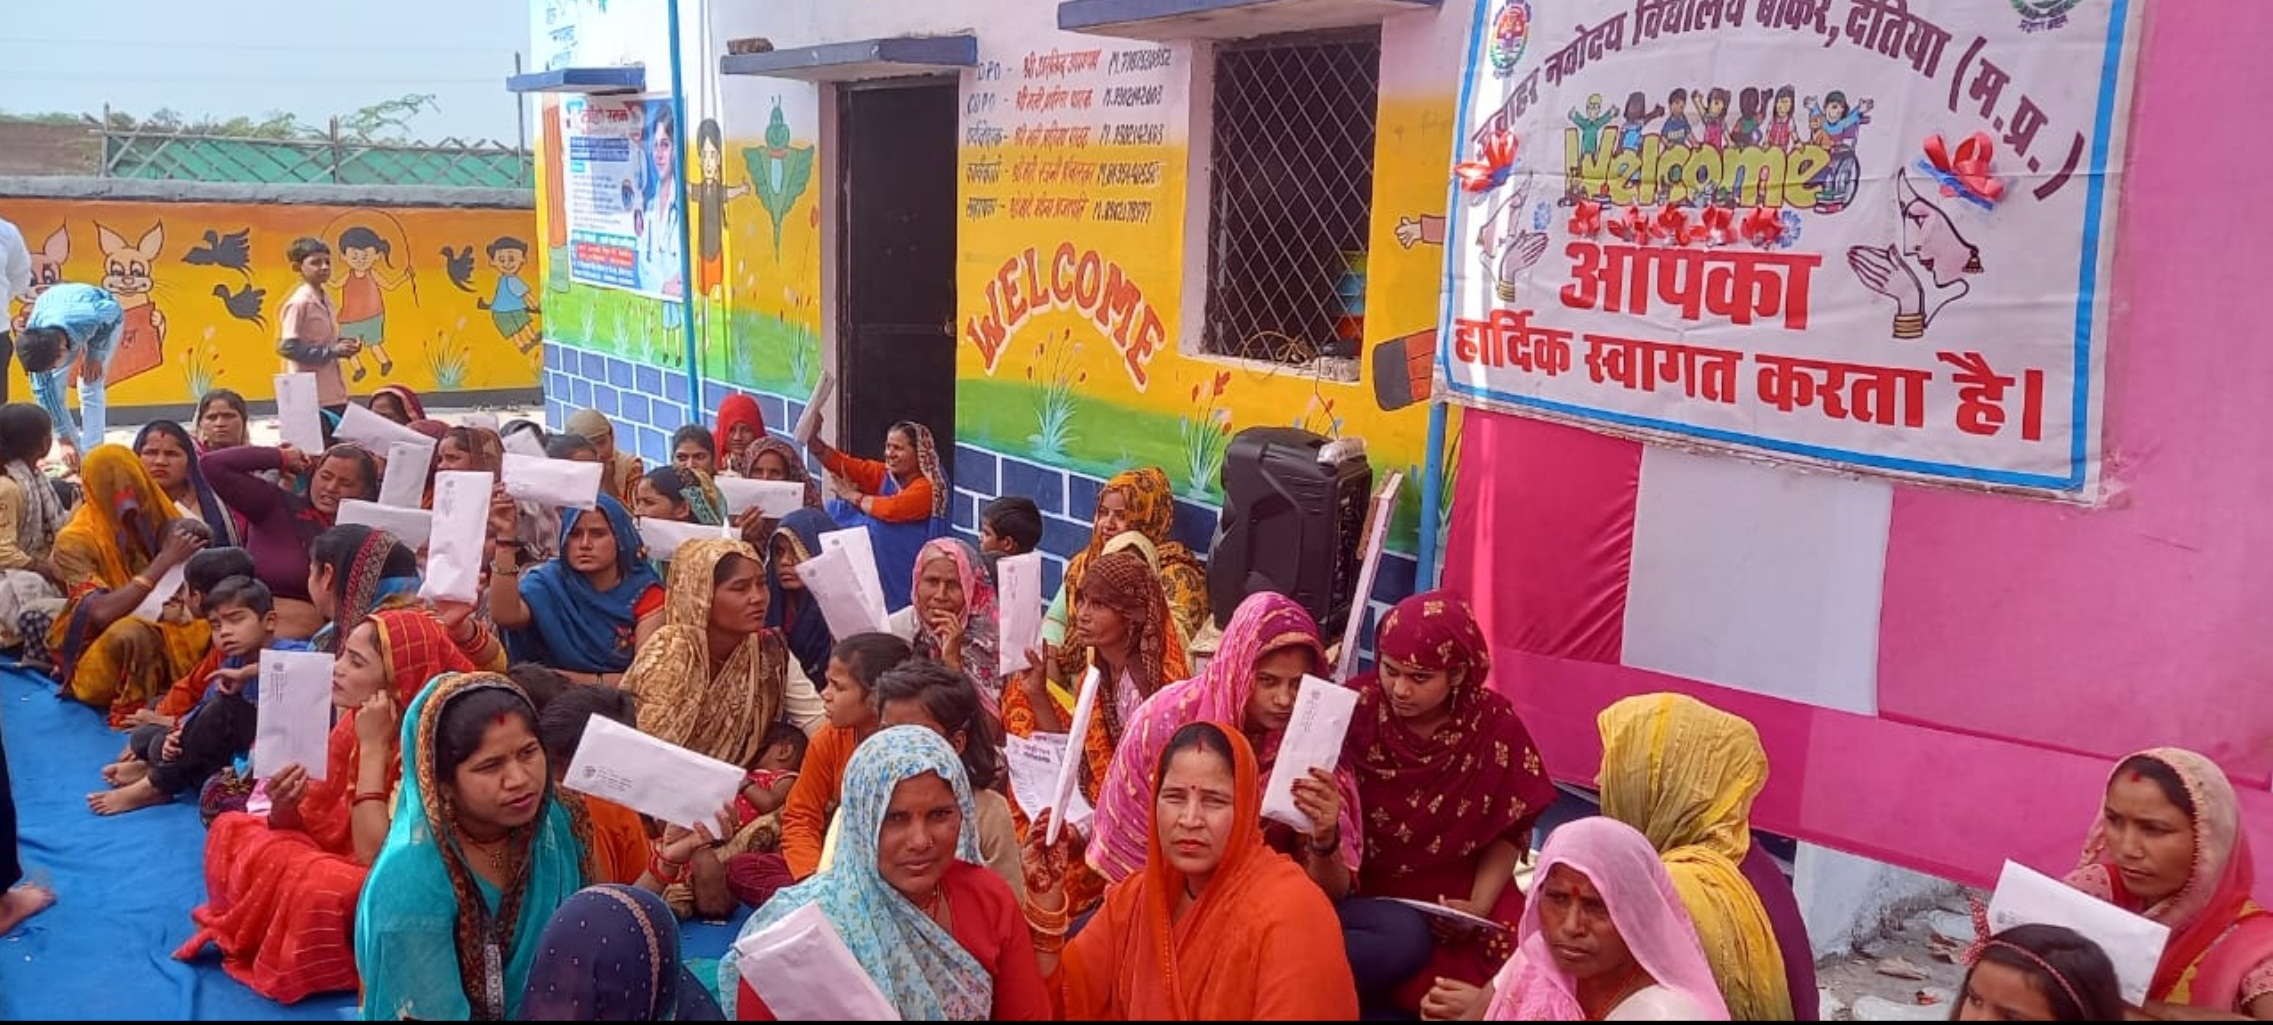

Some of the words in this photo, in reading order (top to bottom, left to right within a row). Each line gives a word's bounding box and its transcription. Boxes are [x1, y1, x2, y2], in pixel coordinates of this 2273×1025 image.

[1545, 12, 1627, 87] नवोदय
[1564, 126, 1832, 208] Welcome
[966, 241, 1166, 388] WELCOME
[1560, 241, 1822, 330] आपका
[1455, 309, 1573, 376] हार्दिक
[1583, 334, 1743, 404] स्वागत
[1755, 353, 1933, 428] करता
